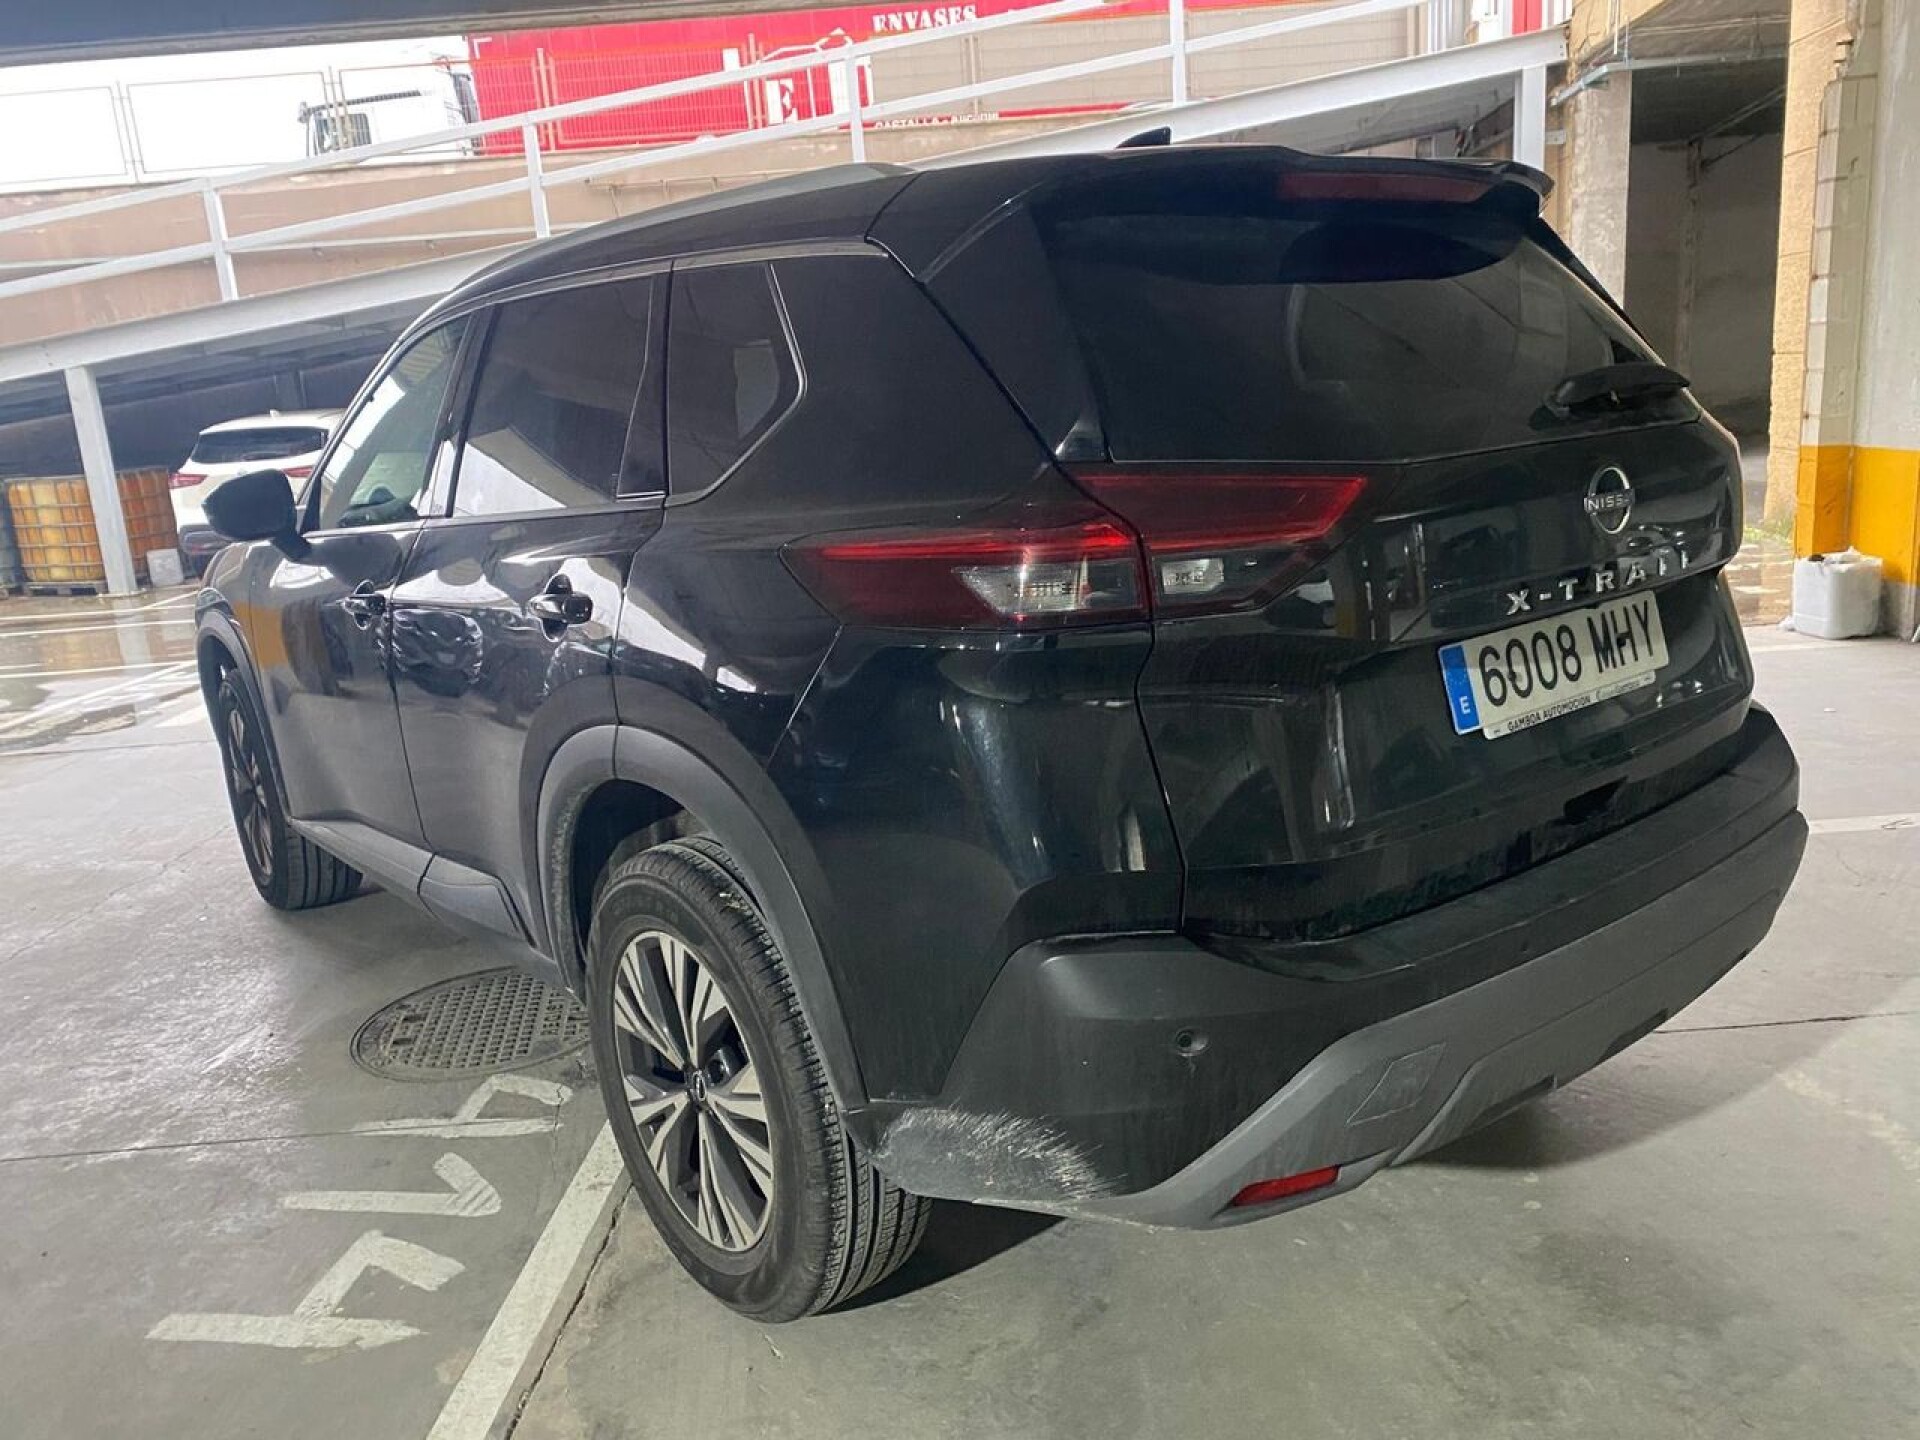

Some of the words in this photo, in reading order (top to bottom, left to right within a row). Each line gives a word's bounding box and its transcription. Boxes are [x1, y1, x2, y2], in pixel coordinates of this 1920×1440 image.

[872, 4, 977, 32] ENVASES
[1479, 624, 1582, 706] 6008
[1587, 600, 1654, 673] MHY
[1460, 696, 1471, 715] E
[1507, 711, 1541, 732] GAMBOA
